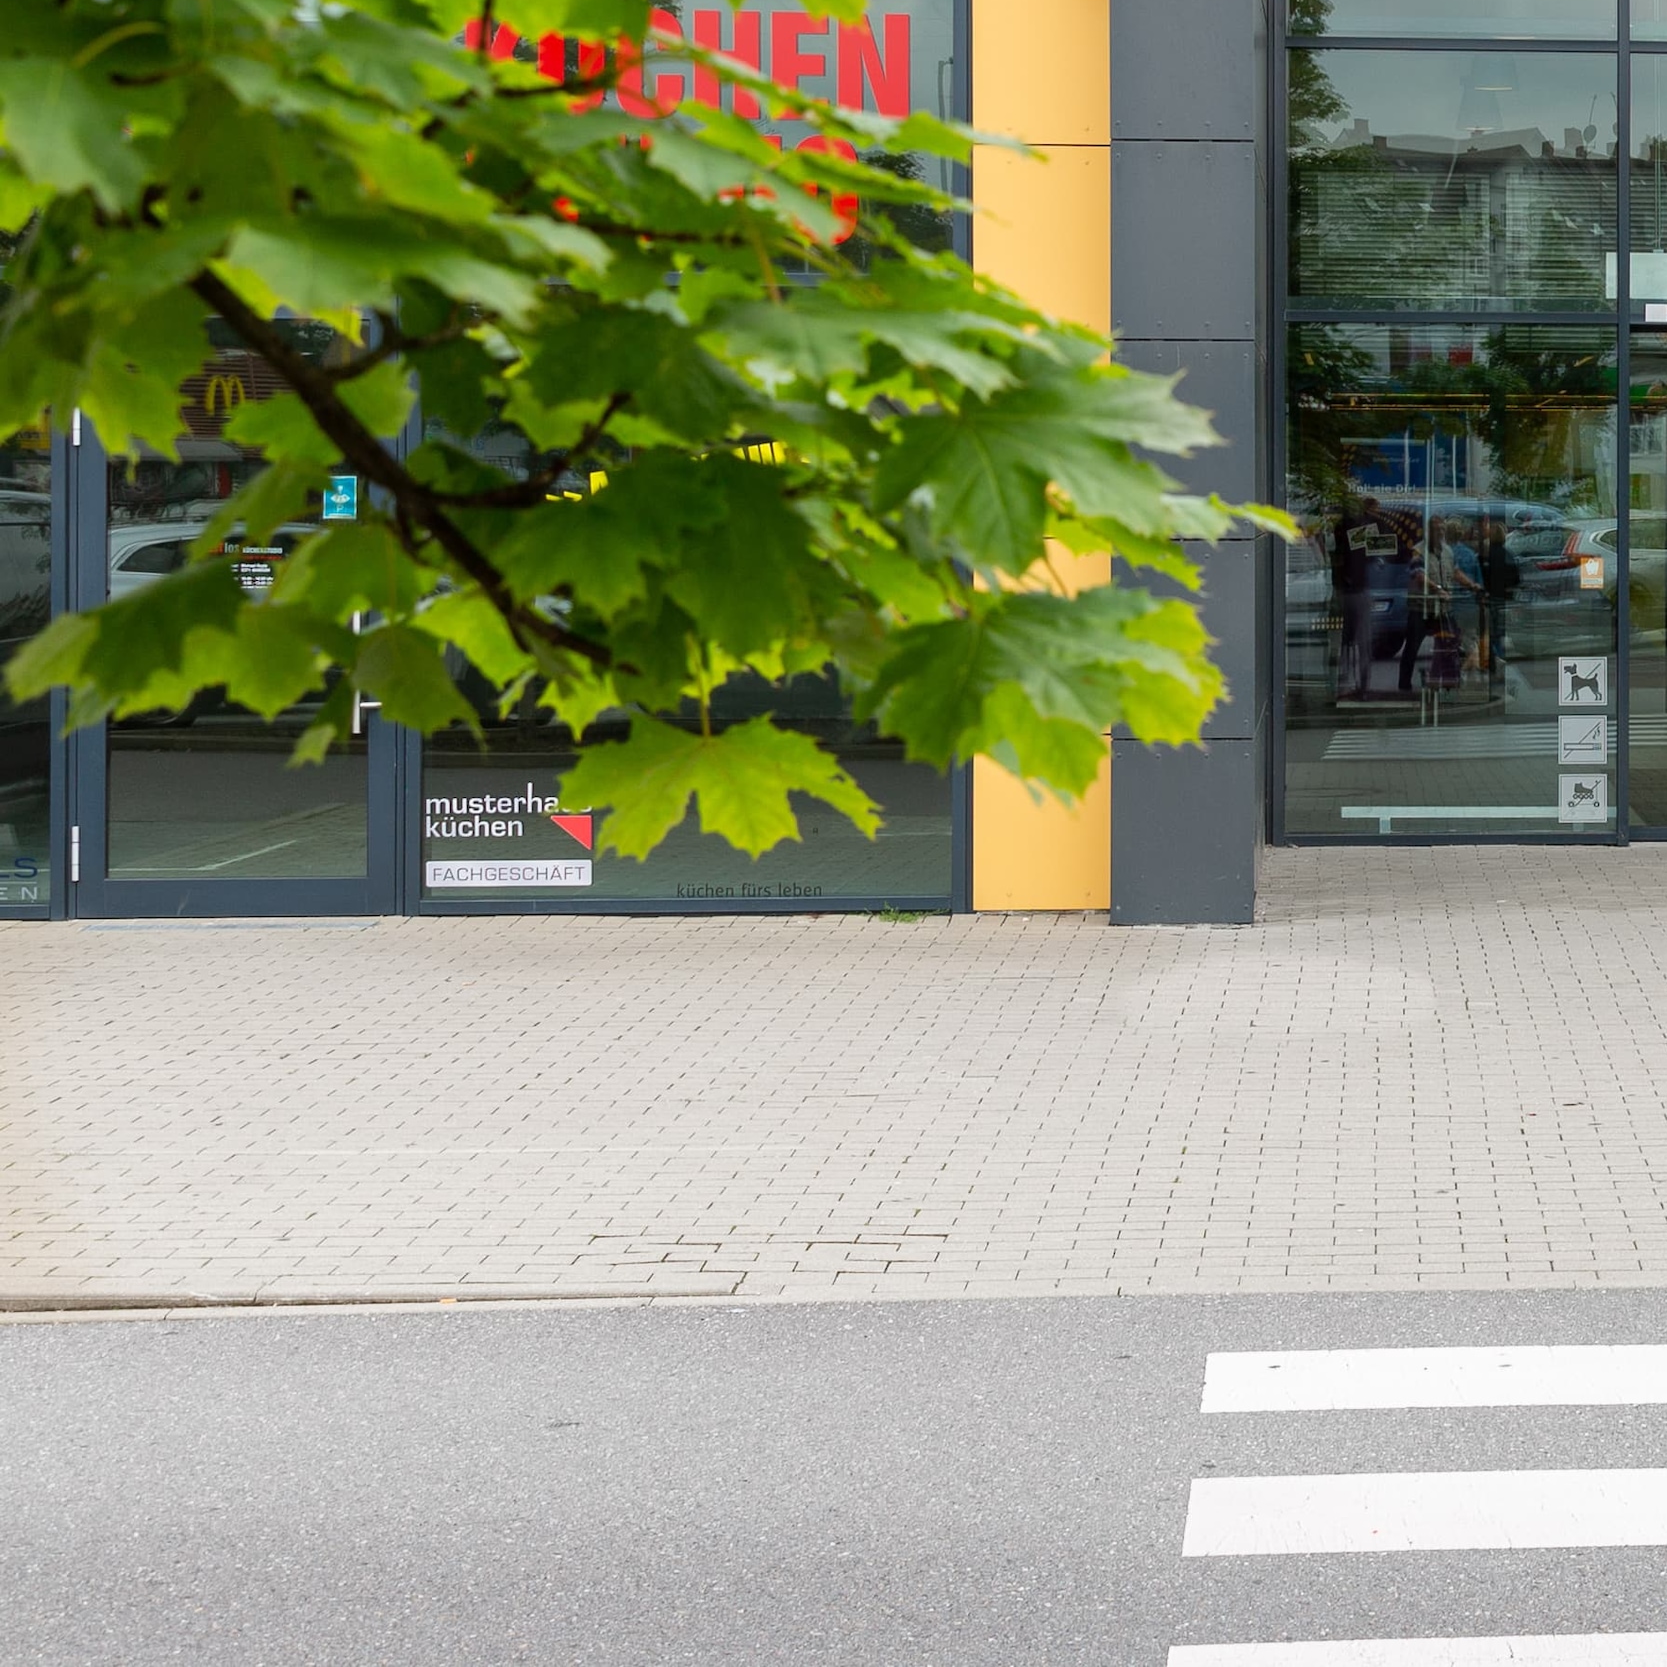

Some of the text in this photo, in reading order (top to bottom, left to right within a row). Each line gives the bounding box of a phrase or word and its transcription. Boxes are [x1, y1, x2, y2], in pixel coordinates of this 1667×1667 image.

[425, 782, 592, 815] musterha
[425, 816, 523, 838] küchen
[432, 865, 586, 883] FACHGESCHÄFT
[677, 883, 823, 899] küchen fürs leben
